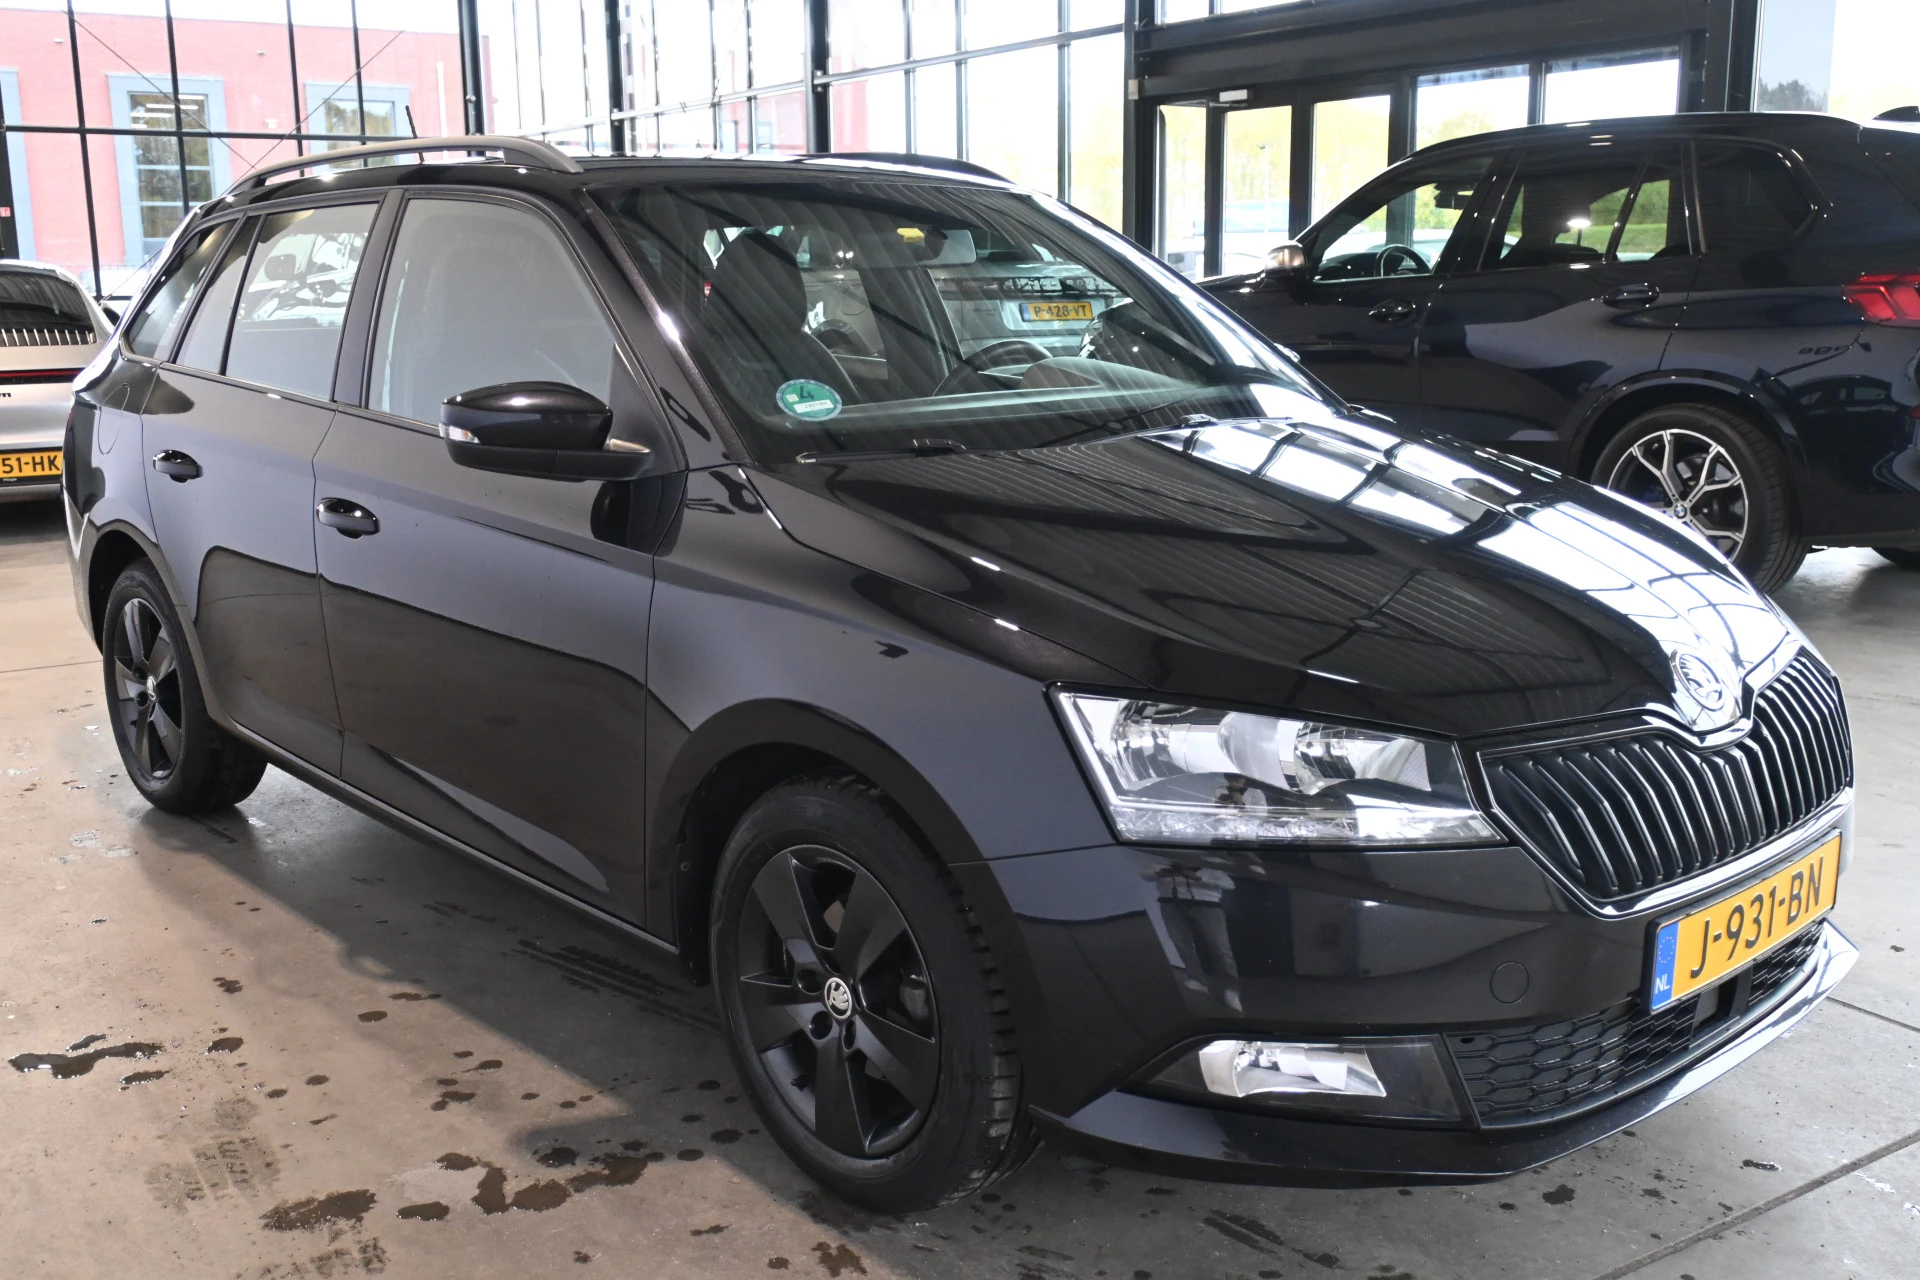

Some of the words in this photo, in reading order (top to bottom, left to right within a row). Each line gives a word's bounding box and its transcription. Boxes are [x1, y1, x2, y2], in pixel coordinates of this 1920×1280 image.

[1033, 304, 1087, 318] P-428-VT
[800, 385, 815, 400] 4
[1, 455, 61, 475] 51-HK
[1690, 855, 1825, 980] J-931-BN
[1655, 973, 1671, 995] NL
